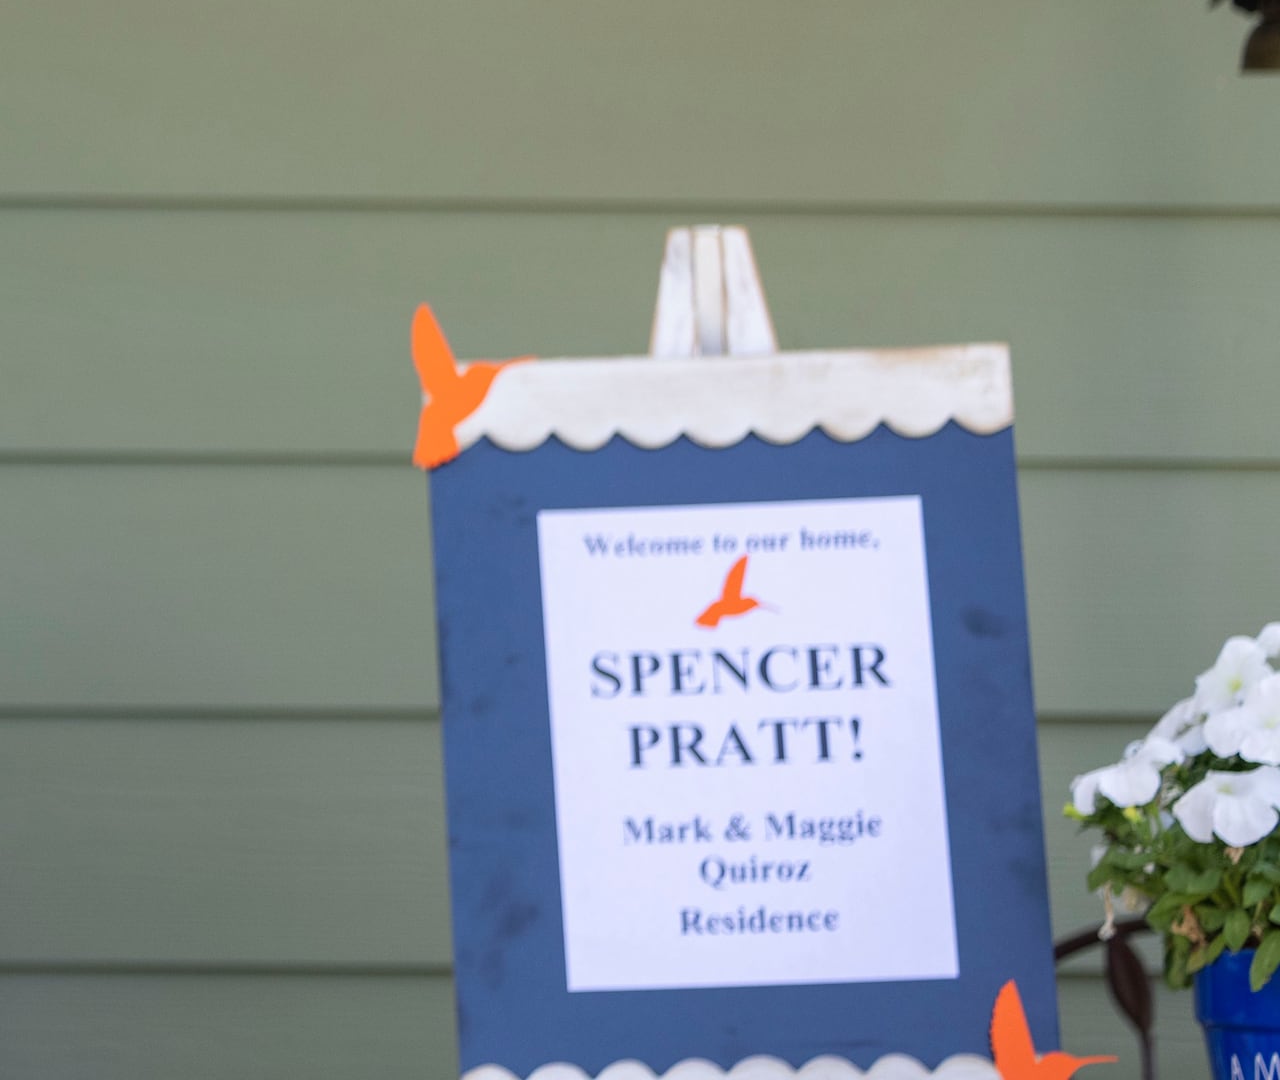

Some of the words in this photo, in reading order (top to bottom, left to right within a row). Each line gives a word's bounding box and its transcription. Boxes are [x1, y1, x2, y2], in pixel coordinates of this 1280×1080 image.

[583, 532, 704, 557] Welcome
[712, 533, 739, 553] to
[745, 533, 790, 552] our
[590, 643, 892, 698] SPENCER
[628, 716, 864, 769] PRATT!
[623, 815, 713, 845] Mark
[723, 813, 752, 843] &
[764, 809, 883, 846] Maggie
[698, 855, 811, 891] Quiroz
[679, 905, 840, 936] Residence
